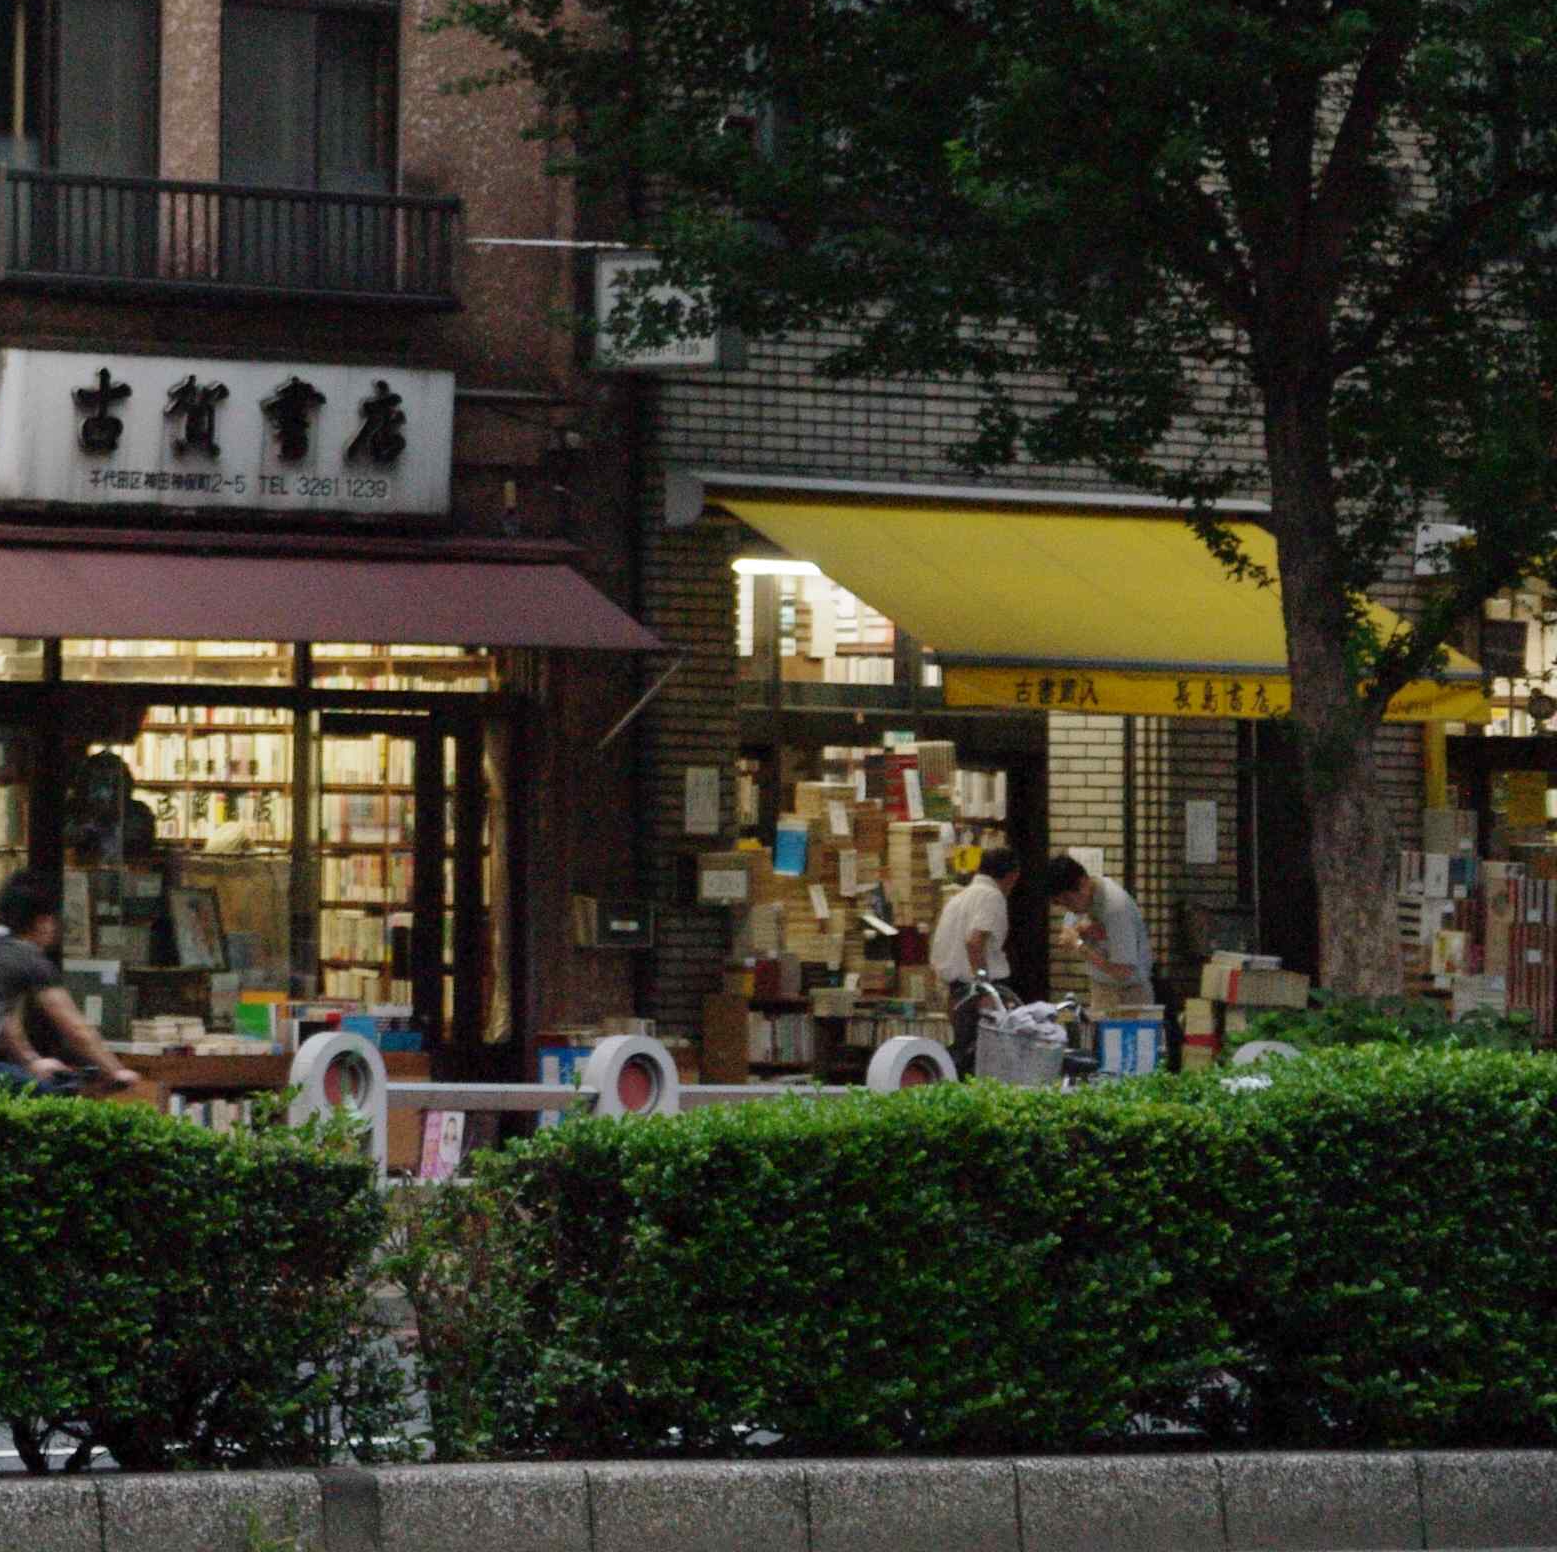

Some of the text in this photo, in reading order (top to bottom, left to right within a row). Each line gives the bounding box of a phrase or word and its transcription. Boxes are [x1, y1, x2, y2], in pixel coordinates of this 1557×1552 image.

[72, 366, 406, 463] 古賀書店
[259, 475, 290, 495] TEL
